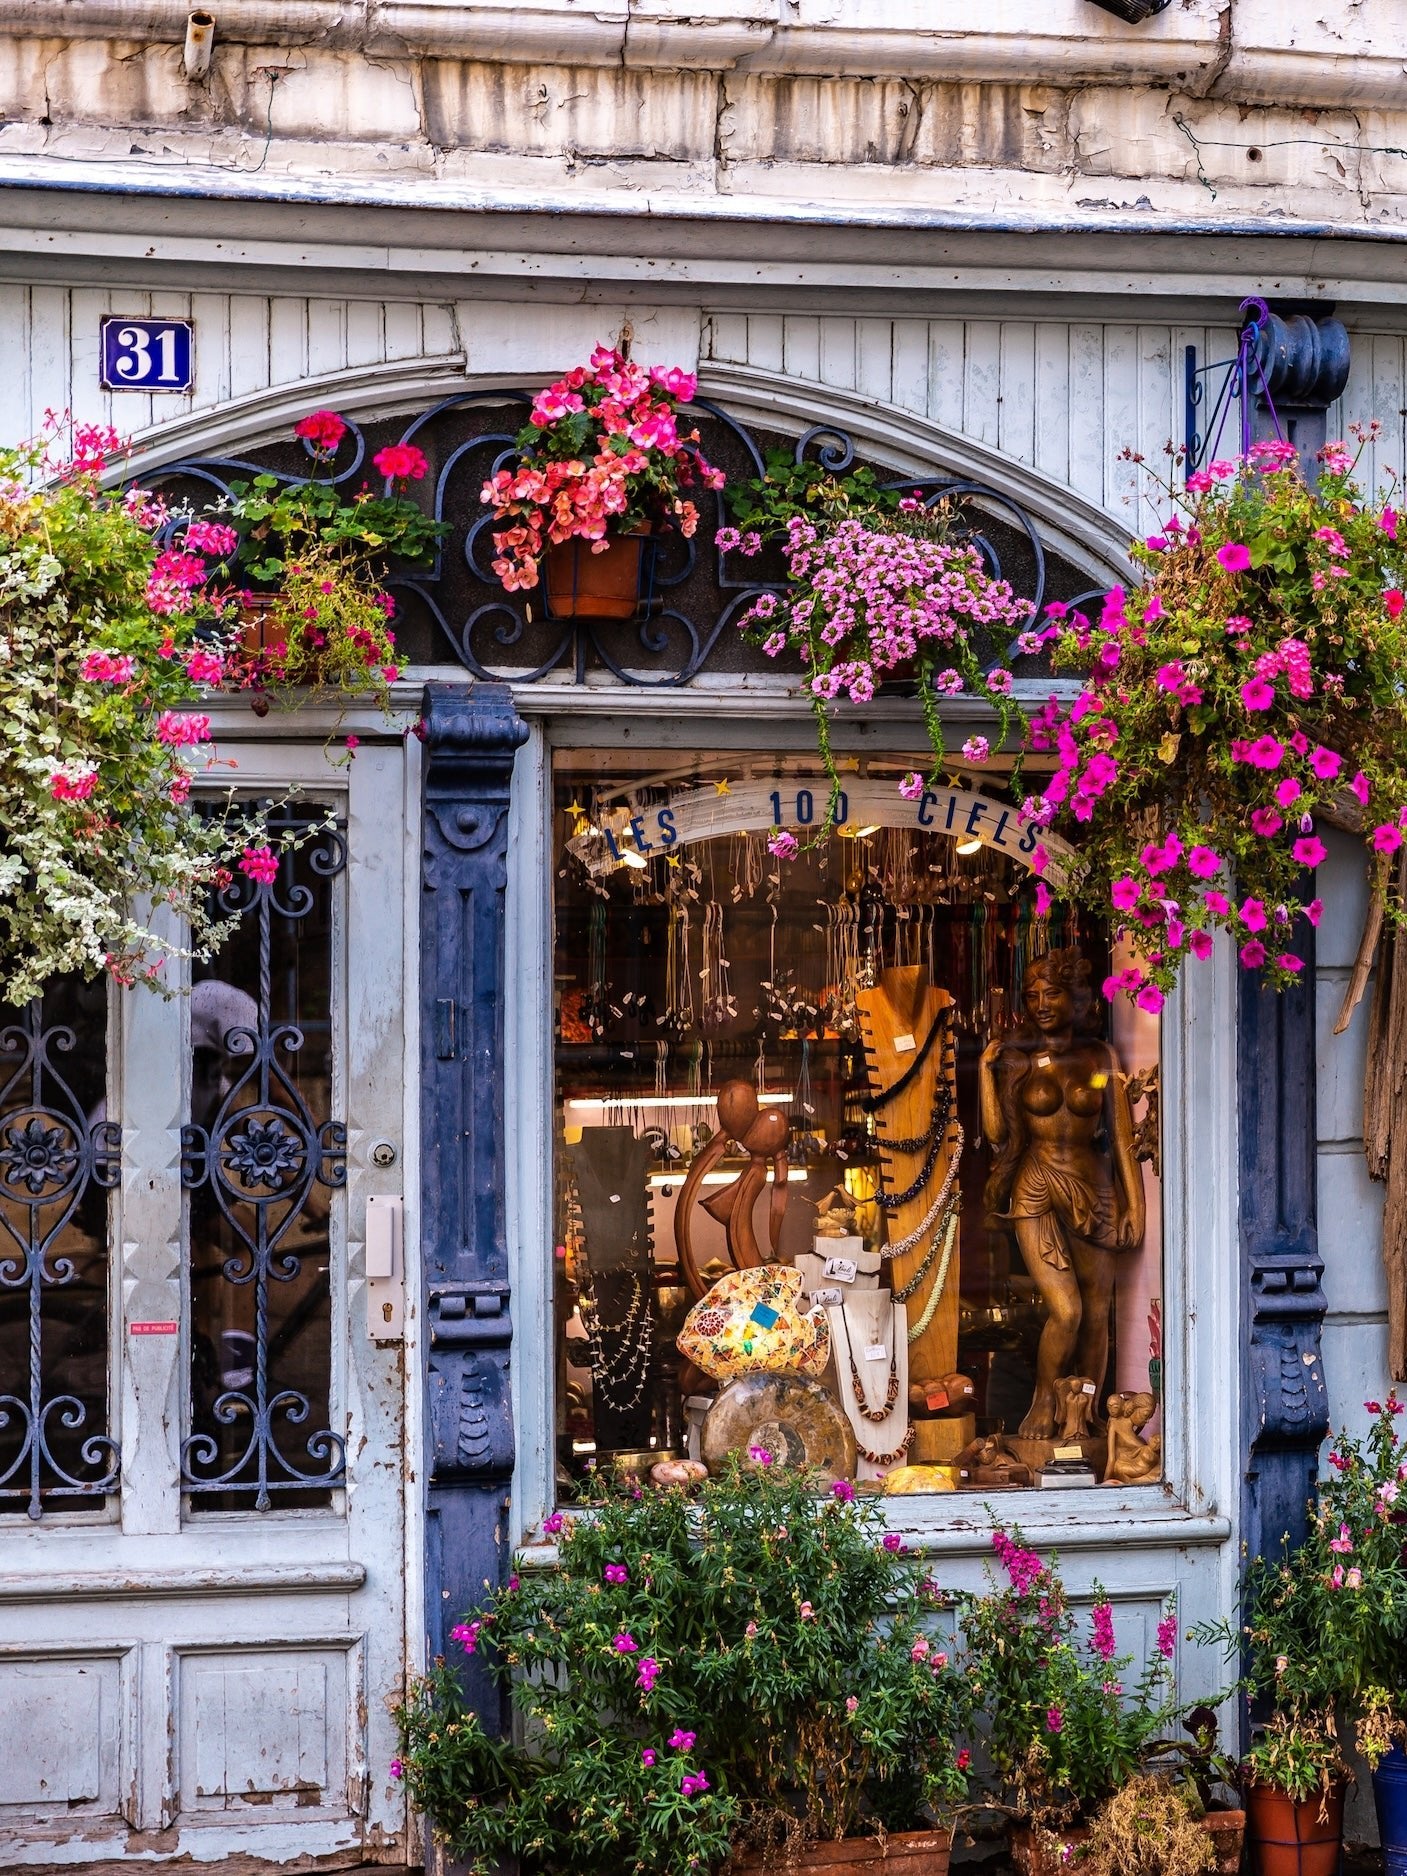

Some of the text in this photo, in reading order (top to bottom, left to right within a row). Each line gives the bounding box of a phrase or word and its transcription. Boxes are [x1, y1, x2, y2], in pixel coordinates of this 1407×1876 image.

[116, 327, 180, 381] 31
[604, 789, 1043, 861] LES 100 CIELS
